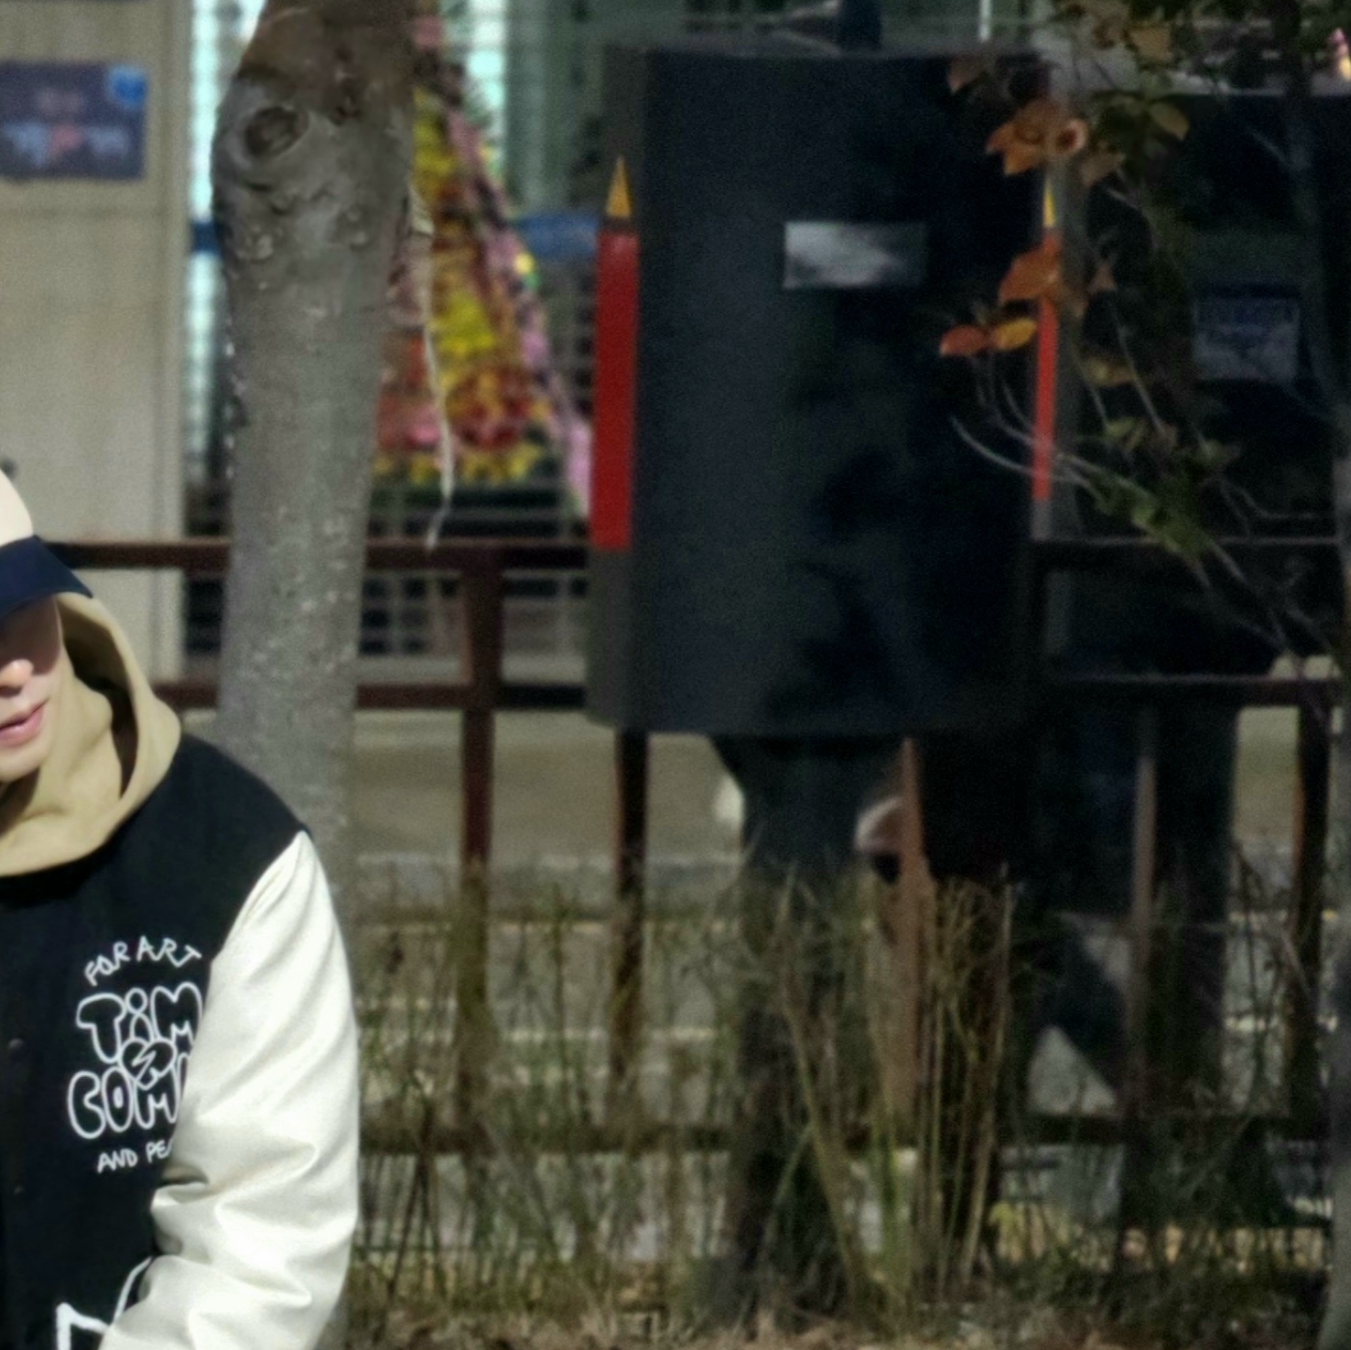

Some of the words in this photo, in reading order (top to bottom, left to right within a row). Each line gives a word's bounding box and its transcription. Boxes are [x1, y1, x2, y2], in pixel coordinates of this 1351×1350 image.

[84, 941, 130, 987] FOR
[136, 935, 203, 968] ART
[97, 1149, 138, 1174] AND
